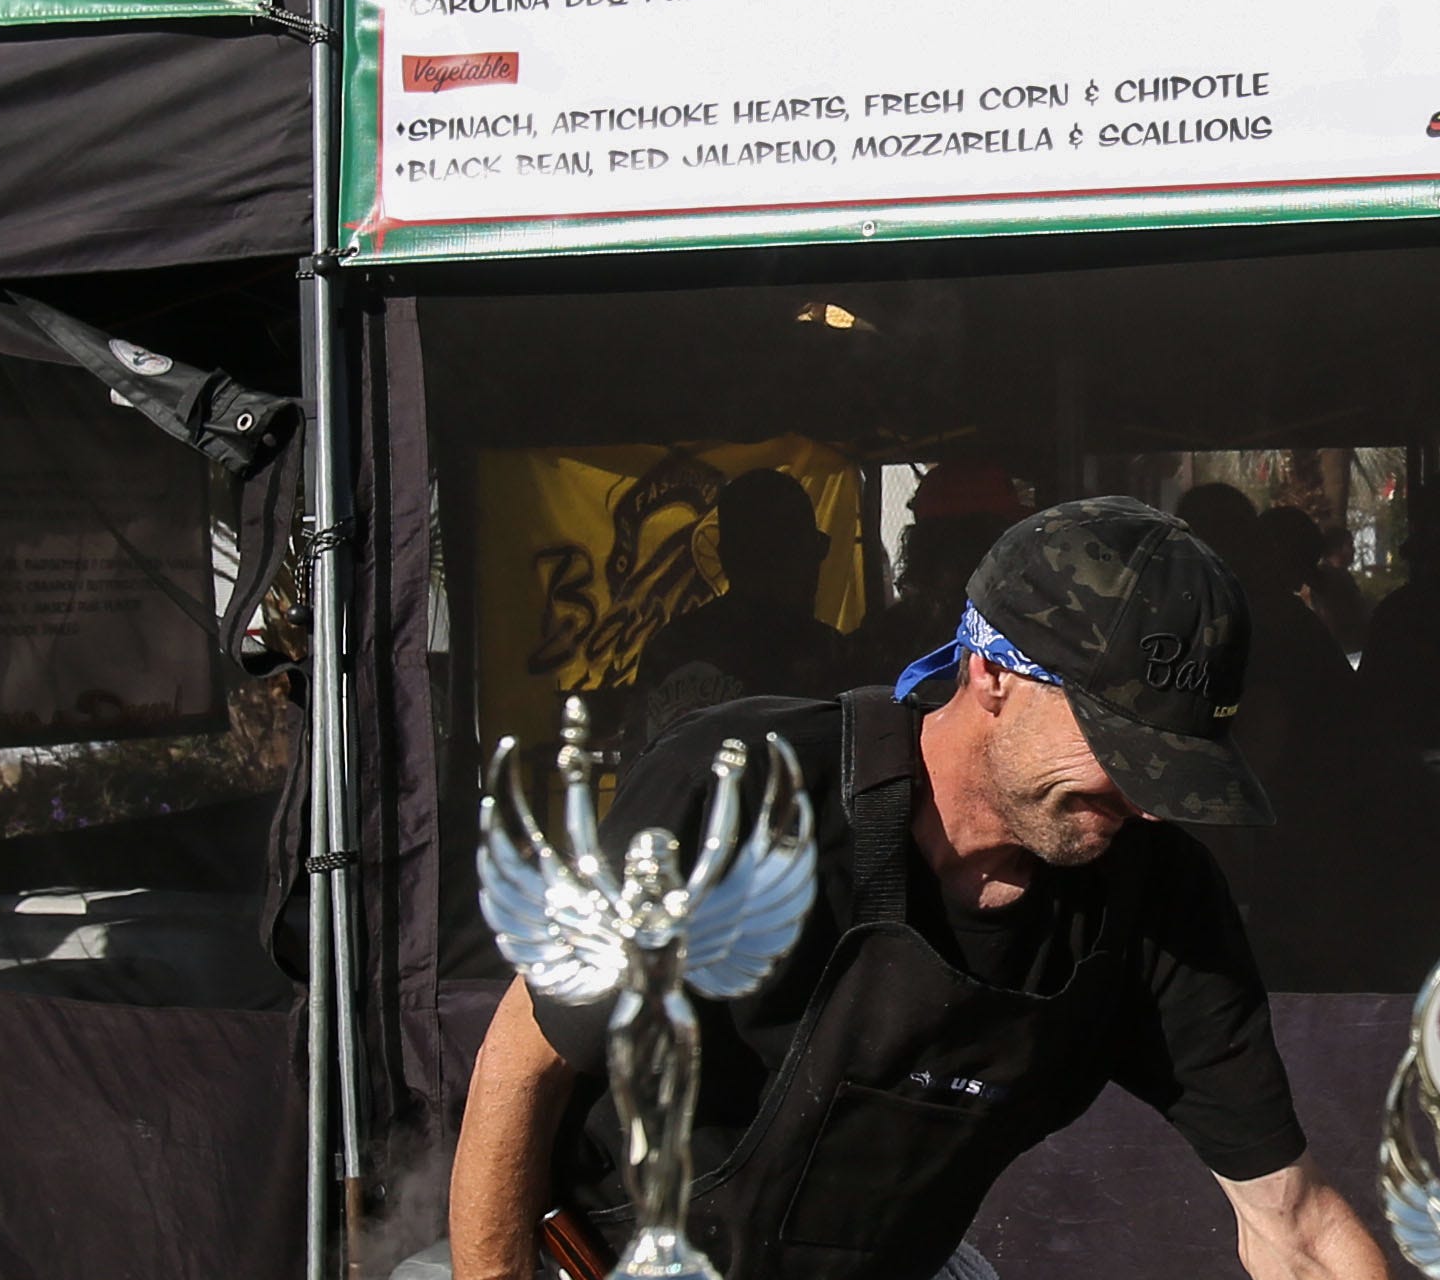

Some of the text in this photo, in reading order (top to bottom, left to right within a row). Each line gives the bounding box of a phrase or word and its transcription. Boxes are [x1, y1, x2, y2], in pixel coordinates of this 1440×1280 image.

[411, 55, 513, 94] Vegetable
[407, 111, 538, 143] SPINACH,
[550, 100, 720, 136] ARTICHOKE
[732, 94, 850, 125] HEARTS,
[864, 87, 965, 117] FRESH
[978, 81, 1070, 111] CORN
[1113, 71, 1271, 104] CHIPOTLE
